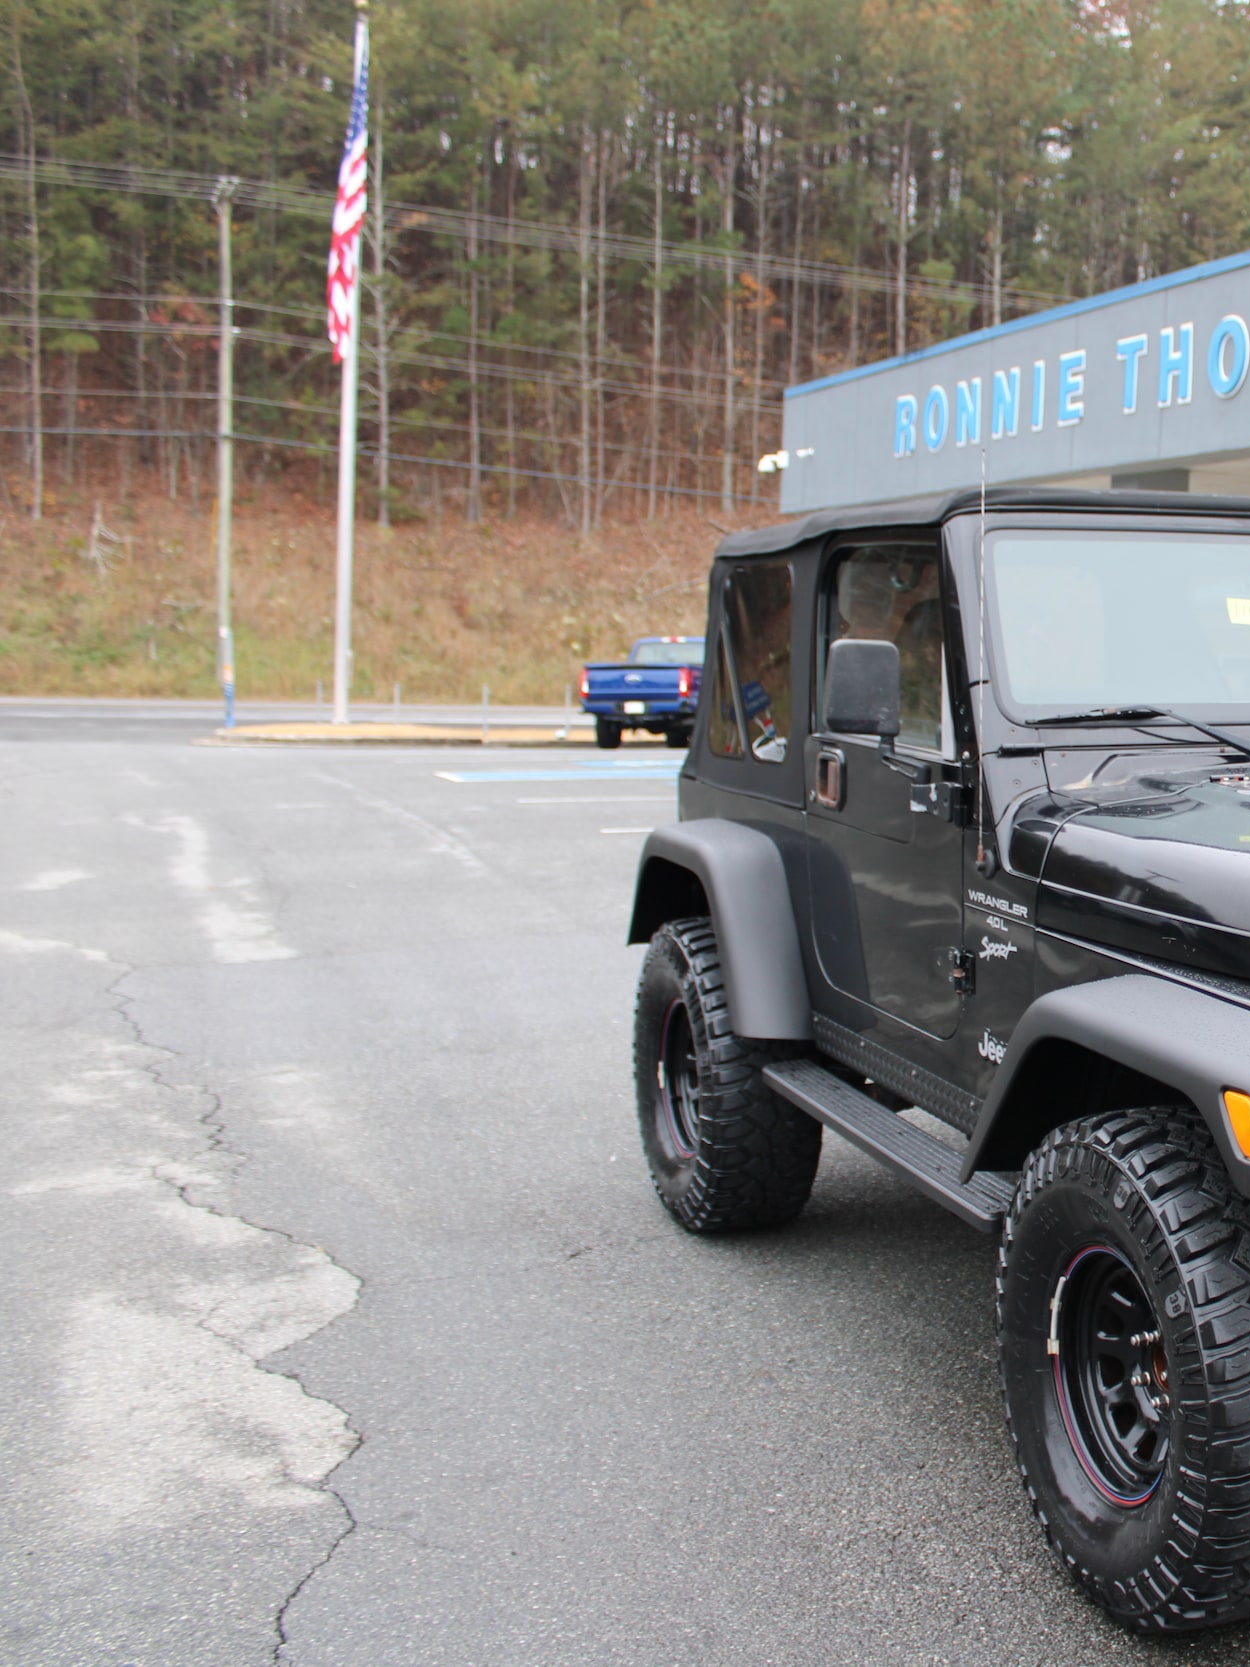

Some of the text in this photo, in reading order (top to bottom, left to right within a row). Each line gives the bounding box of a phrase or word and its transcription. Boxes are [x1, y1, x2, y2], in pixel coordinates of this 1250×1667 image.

[893, 348, 1087, 458] RONNIE
[968, 889, 1028, 918] WRANGLER
[978, 1028, 1007, 1065] Jee
